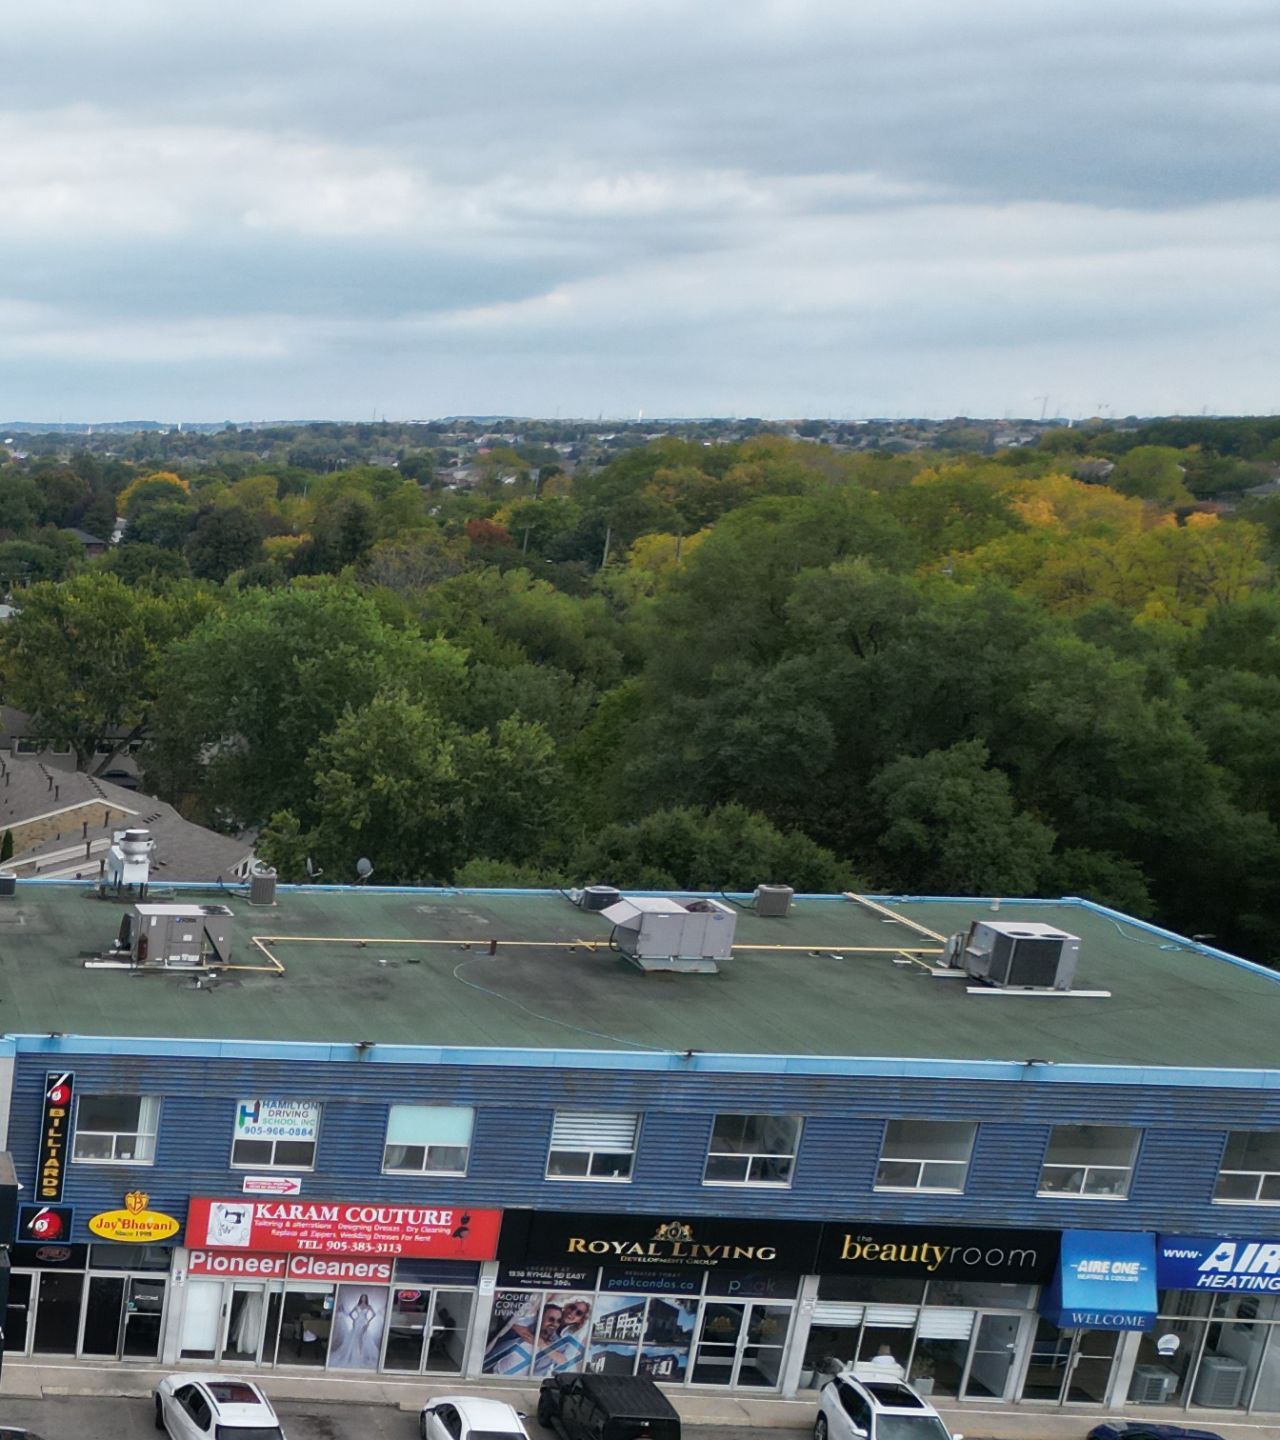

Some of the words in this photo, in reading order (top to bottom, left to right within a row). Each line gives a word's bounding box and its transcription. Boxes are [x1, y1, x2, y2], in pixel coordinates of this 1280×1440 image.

[262, 1101, 318, 1111] HAMILTON
[268, 1110, 309, 1119] DRIVING
[262, 1117, 298, 1126] SCHOOL
[300, 1118, 316, 1127] INC
[42, 1108, 65, 1197] BILLIARDS
[255, 1203, 339, 1222] KARAM
[344, 1206, 453, 1226] COUTURE
[96, 1219, 117, 1231] Jay
[122, 1219, 172, 1231] Bhavani
[405, 1225, 419, 1235] Dry
[326, 1240, 402, 1254] 905-383-3113
[568, 1238, 662, 1256] ROYAL
[670, 1242, 776, 1260] LIVING
[189, 1251, 286, 1275] Pioneer
[290, 1255, 391, 1278] Cleaners
[620, 1255, 684, 1265] DEVELOPMENT
[686, 1258, 718, 1266] GROUP
[1077, 1261, 1109, 1273] AIRE
[1112, 1262, 1140, 1274] ONE
[607, 1277, 695, 1291] peakcondos.ca
[1197, 1275, 1280, 1290] HEATING
[496, 1293, 540, 1302] MODERN
[496, 1301, 533, 1310] CONDO
[1071, 1312, 1146, 1327] WELCOME
